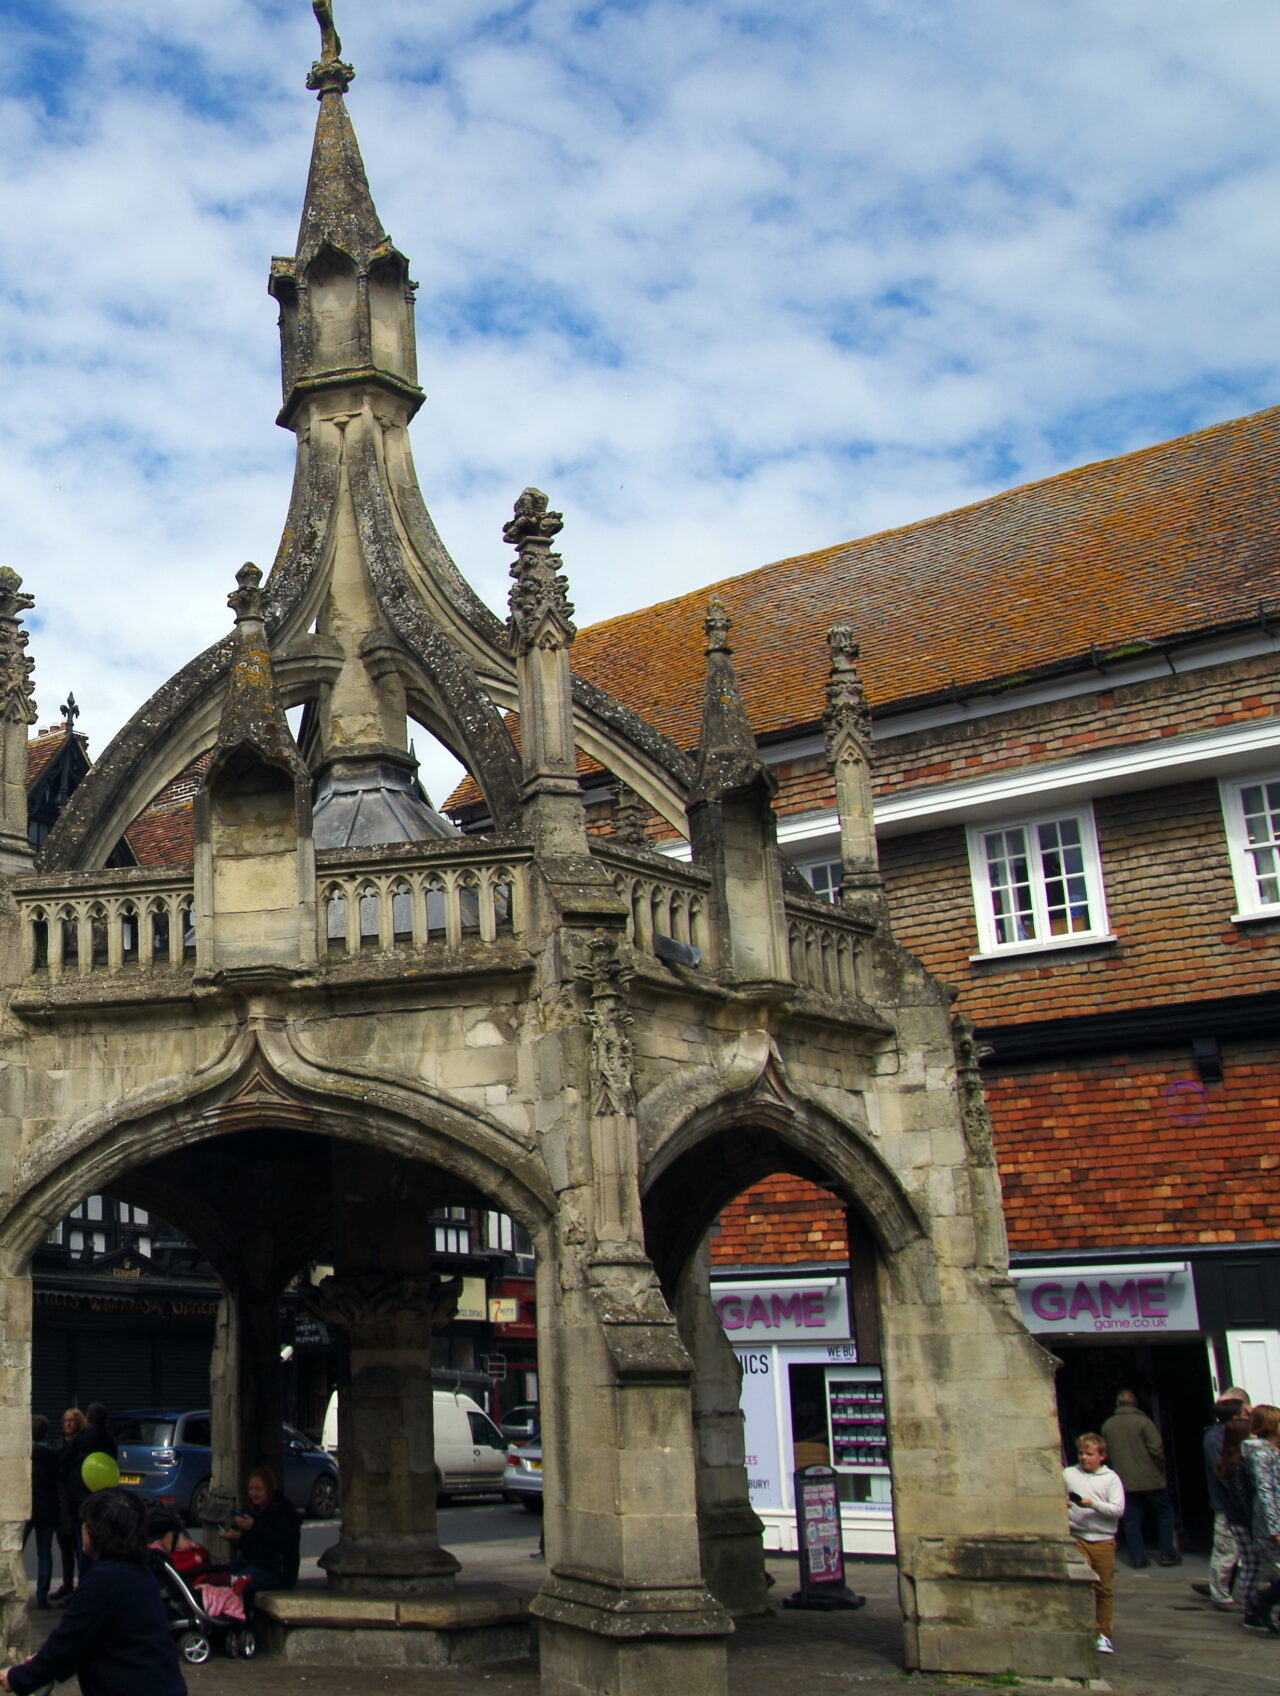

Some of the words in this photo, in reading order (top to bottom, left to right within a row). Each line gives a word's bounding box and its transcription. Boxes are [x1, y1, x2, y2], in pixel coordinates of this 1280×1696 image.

[1031, 1278, 1168, 1320] GAME
[716, 1292, 827, 1330] GAME
[1094, 1317, 1167, 1331] game.co.uk
[827, 1345, 841, 1357] WE
[843, 1345, 855, 1357] BU
[740, 1354, 769, 1374] ICS
